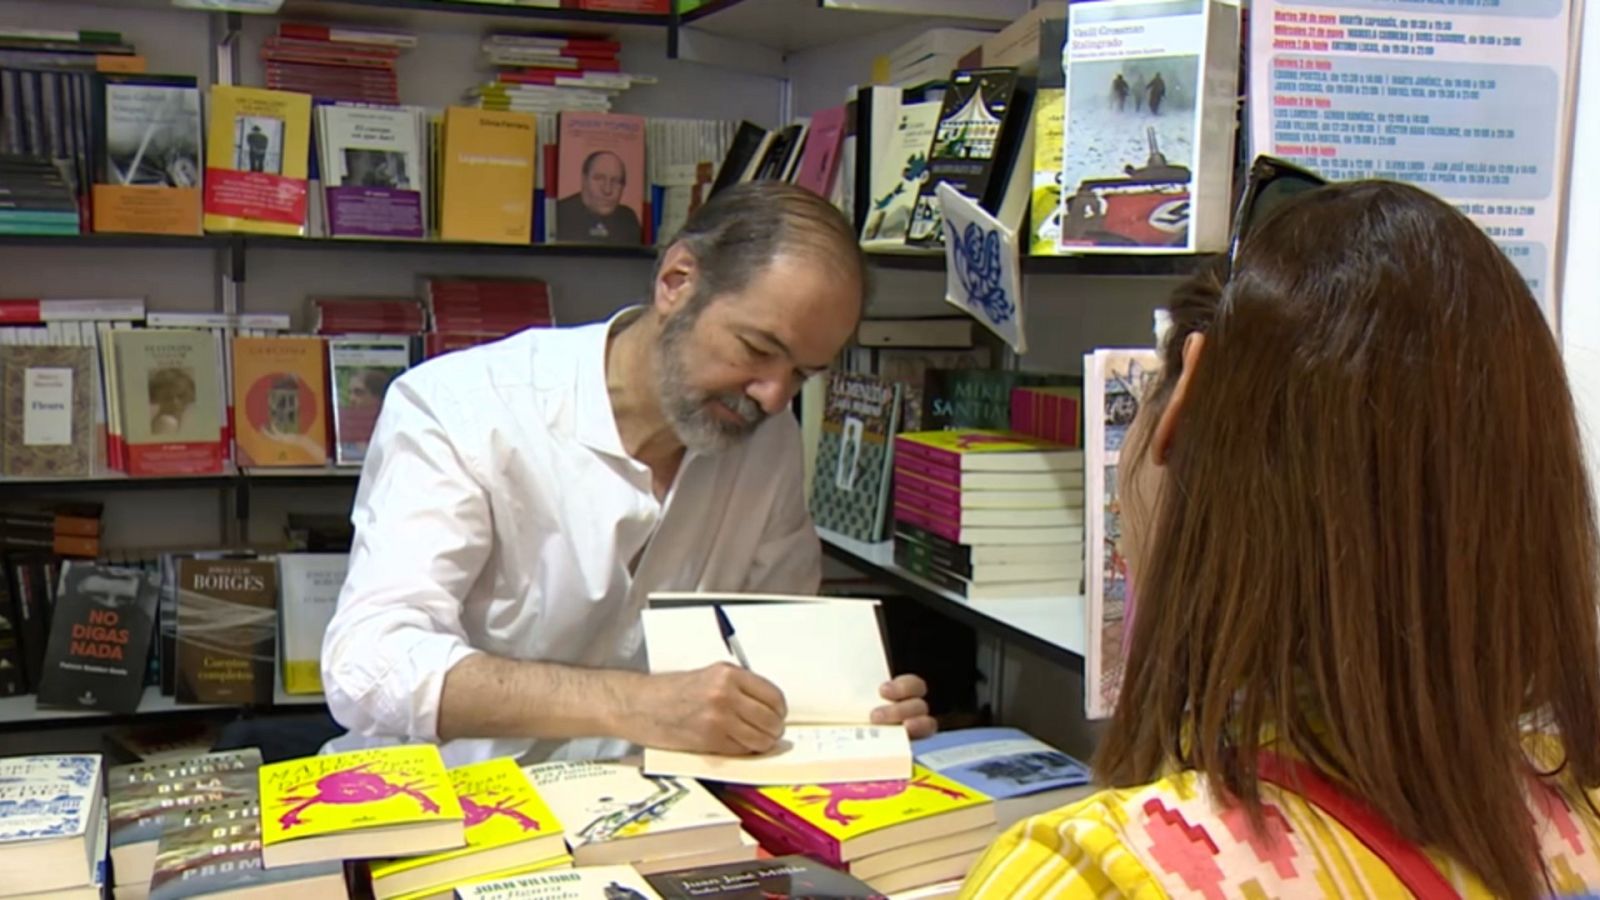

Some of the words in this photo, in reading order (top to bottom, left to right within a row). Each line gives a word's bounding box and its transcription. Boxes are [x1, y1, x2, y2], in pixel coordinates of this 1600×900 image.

[193, 574, 264, 592] BORGES
[89, 608, 119, 627] NO
[71, 623, 129, 644] DIGAS
[69, 641, 124, 660] NADA
[203, 656, 250, 668] Cuentos
[197, 667, 254, 683] completos
[128, 771, 155, 784] LA
[167, 760, 245, 779] TIERRA
[157, 782, 184, 794] DE
[195, 778, 222, 790] LA
[183, 813, 213, 828] LA
[212, 827, 242, 839] DE
[182, 857, 261, 881] PROM
[681, 878, 720, 891] Juan
[722, 873, 755, 884] José
[758, 865, 808, 878] Millás
[474, 881, 517, 895] JUAN
[517, 873, 582, 887] VILLORO
